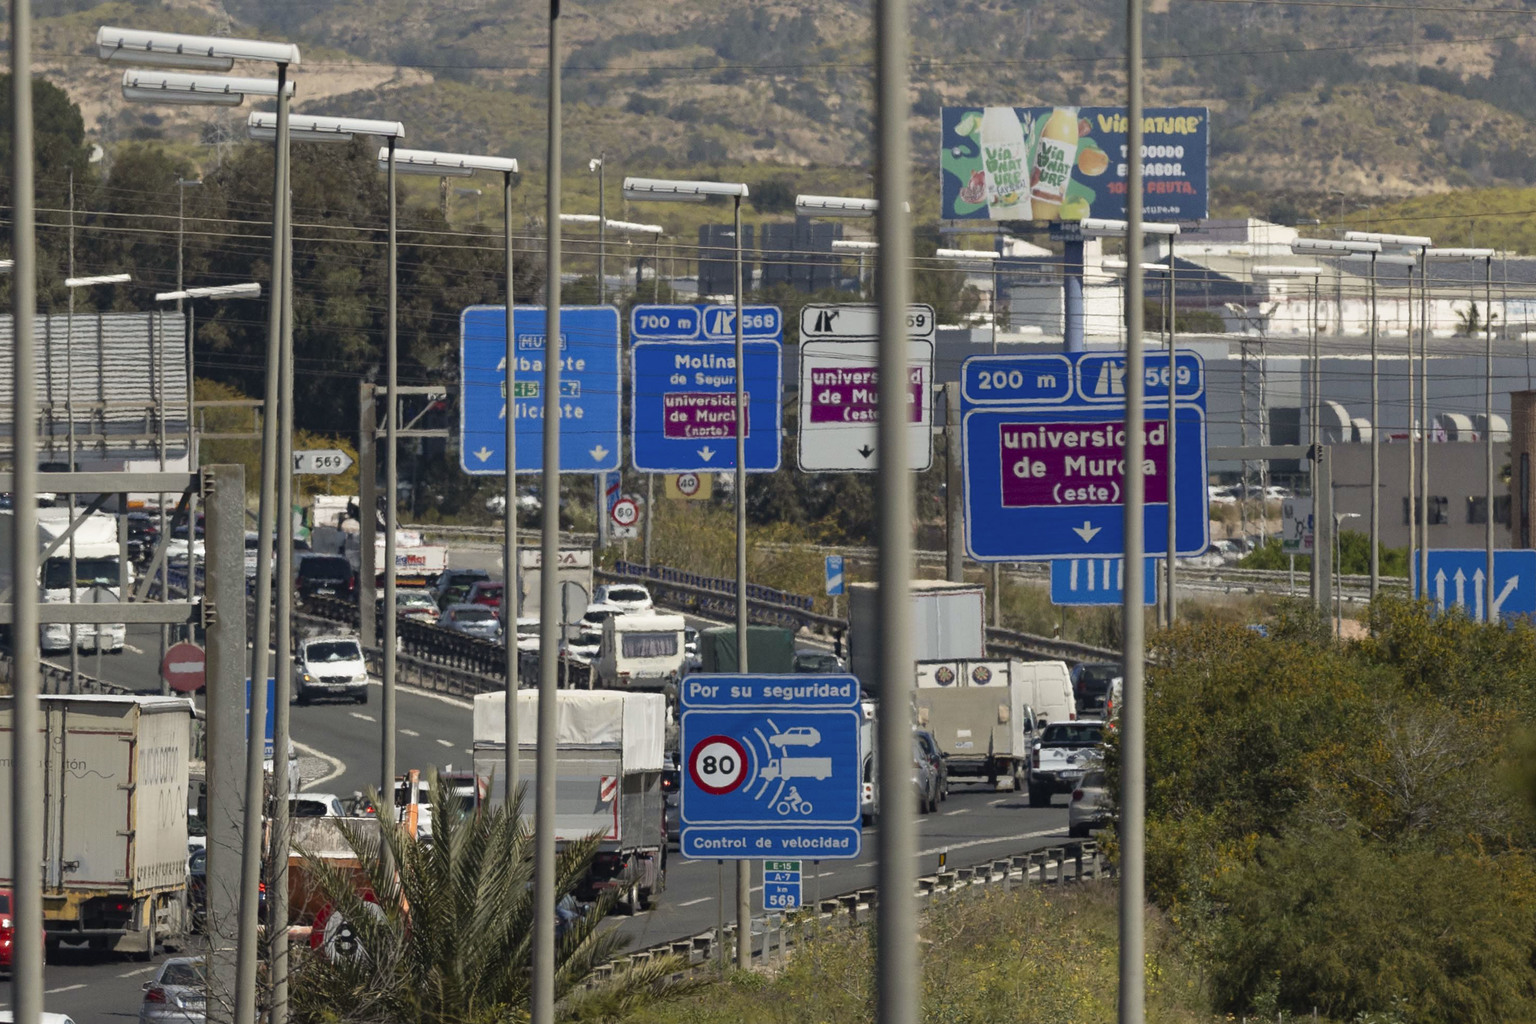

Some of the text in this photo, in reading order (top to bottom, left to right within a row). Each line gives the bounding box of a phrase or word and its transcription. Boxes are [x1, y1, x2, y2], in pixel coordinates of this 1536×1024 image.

[639, 316, 691, 329] 700 m
[742, 314, 775, 328] 568
[906, 314, 926, 327] 69
[496, 357, 586, 372] Albaete
[675, 354, 736, 369] Molina
[670, 372, 737, 387] de Segur
[978, 371, 1056, 389] 200 m
[1146, 366, 1191, 385] 569
[818, 389, 915, 404] de Mua
[670, 410, 737, 422] de Murci
[315, 456, 341, 468] 569
[1013, 456, 1156, 478] de Murca
[1053, 481, 1120, 503] (este)
[690, 682, 851, 700] Por su seguridad
[702, 755, 735, 775] 80
[693, 837, 850, 848] Control de velocidad
[772, 862, 792, 870] E-15
[775, 873, 791, 881] A-7
[769, 895, 795, 907] 569
